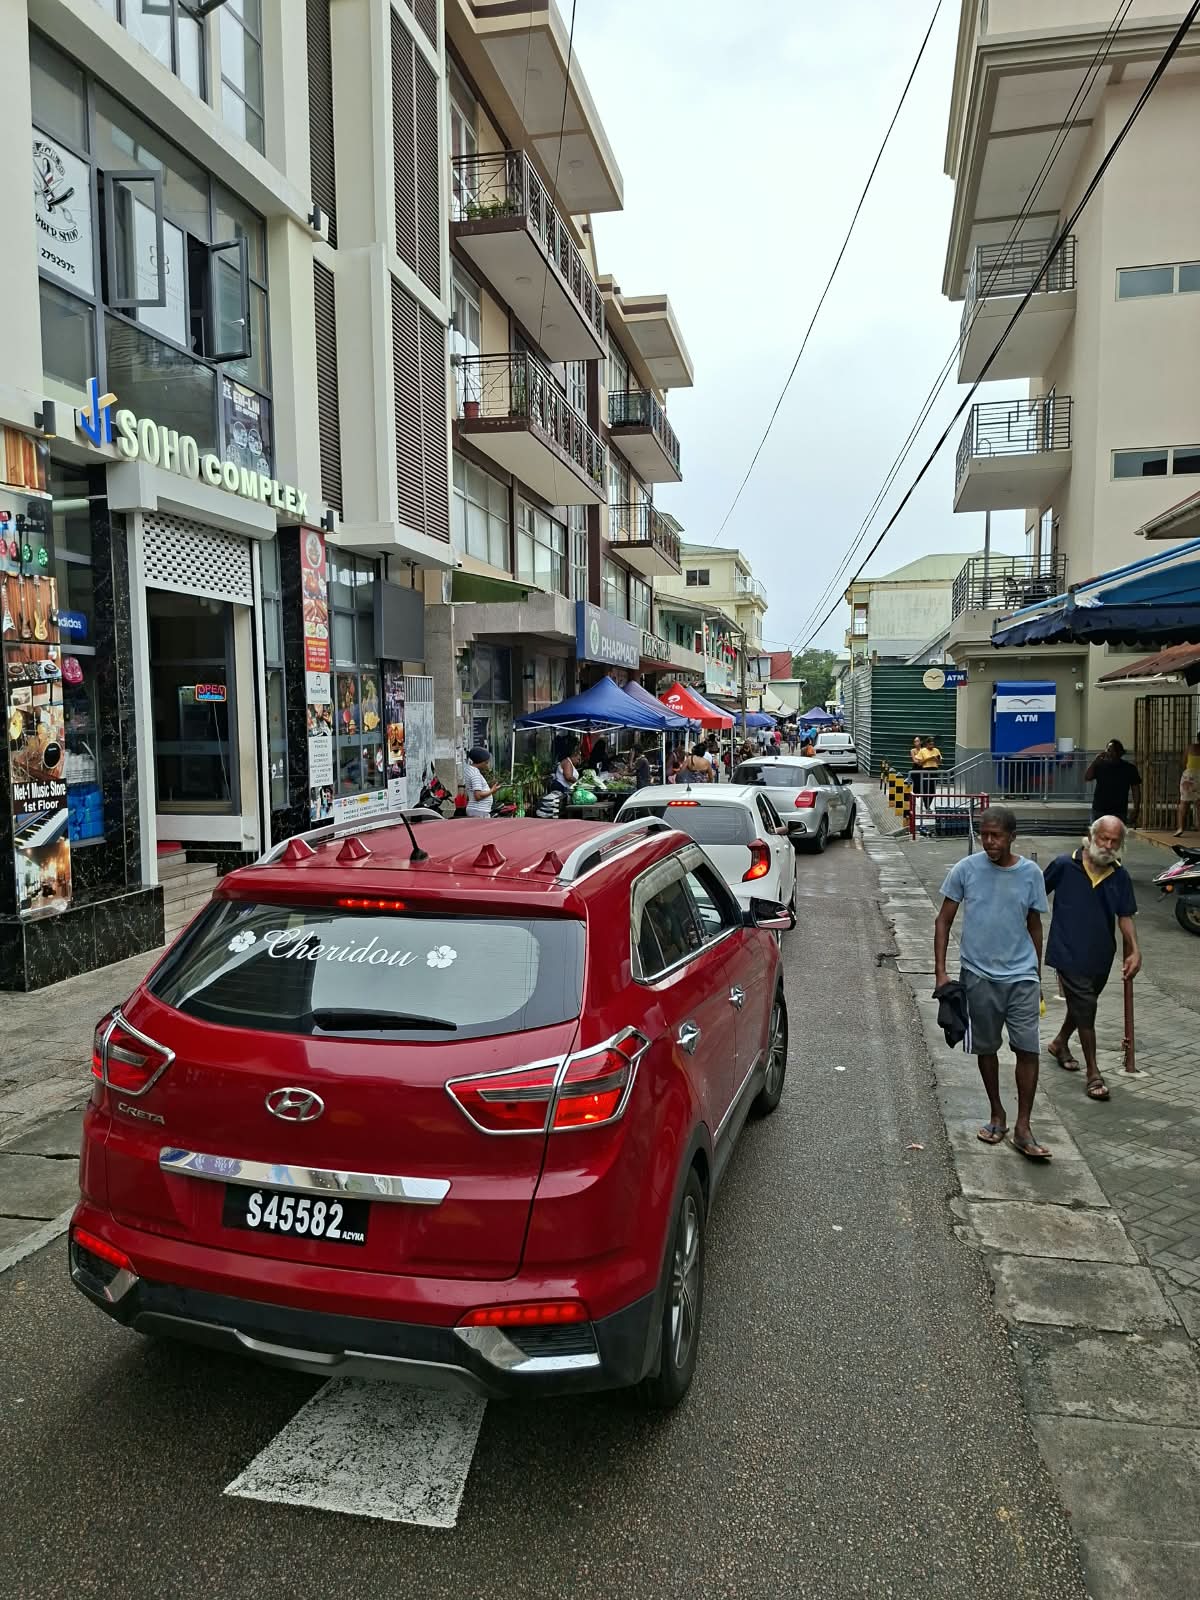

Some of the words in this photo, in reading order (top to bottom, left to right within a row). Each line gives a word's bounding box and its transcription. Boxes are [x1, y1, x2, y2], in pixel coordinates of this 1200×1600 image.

[41, 247, 76, 274] 2792975
[115, 409, 199, 480] SOHO
[201, 453, 308, 517] COMPLEX
[601, 635, 638, 665] PHARMACY
[946, 674, 965, 682] ATM
[198, 684, 225, 696] OPEN
[1015, 714, 1039, 722] ATM
[13, 782, 30, 801] Net-1
[31, 781, 50, 798] Music
[50, 780, 67, 797] Store
[23, 801, 37, 813] 1st
[37, 800, 59, 811] Floor
[264, 928, 419, 967] Cheridou
[118, 1102, 165, 1125] CRETA
[246, 1192, 344, 1239] S45582
